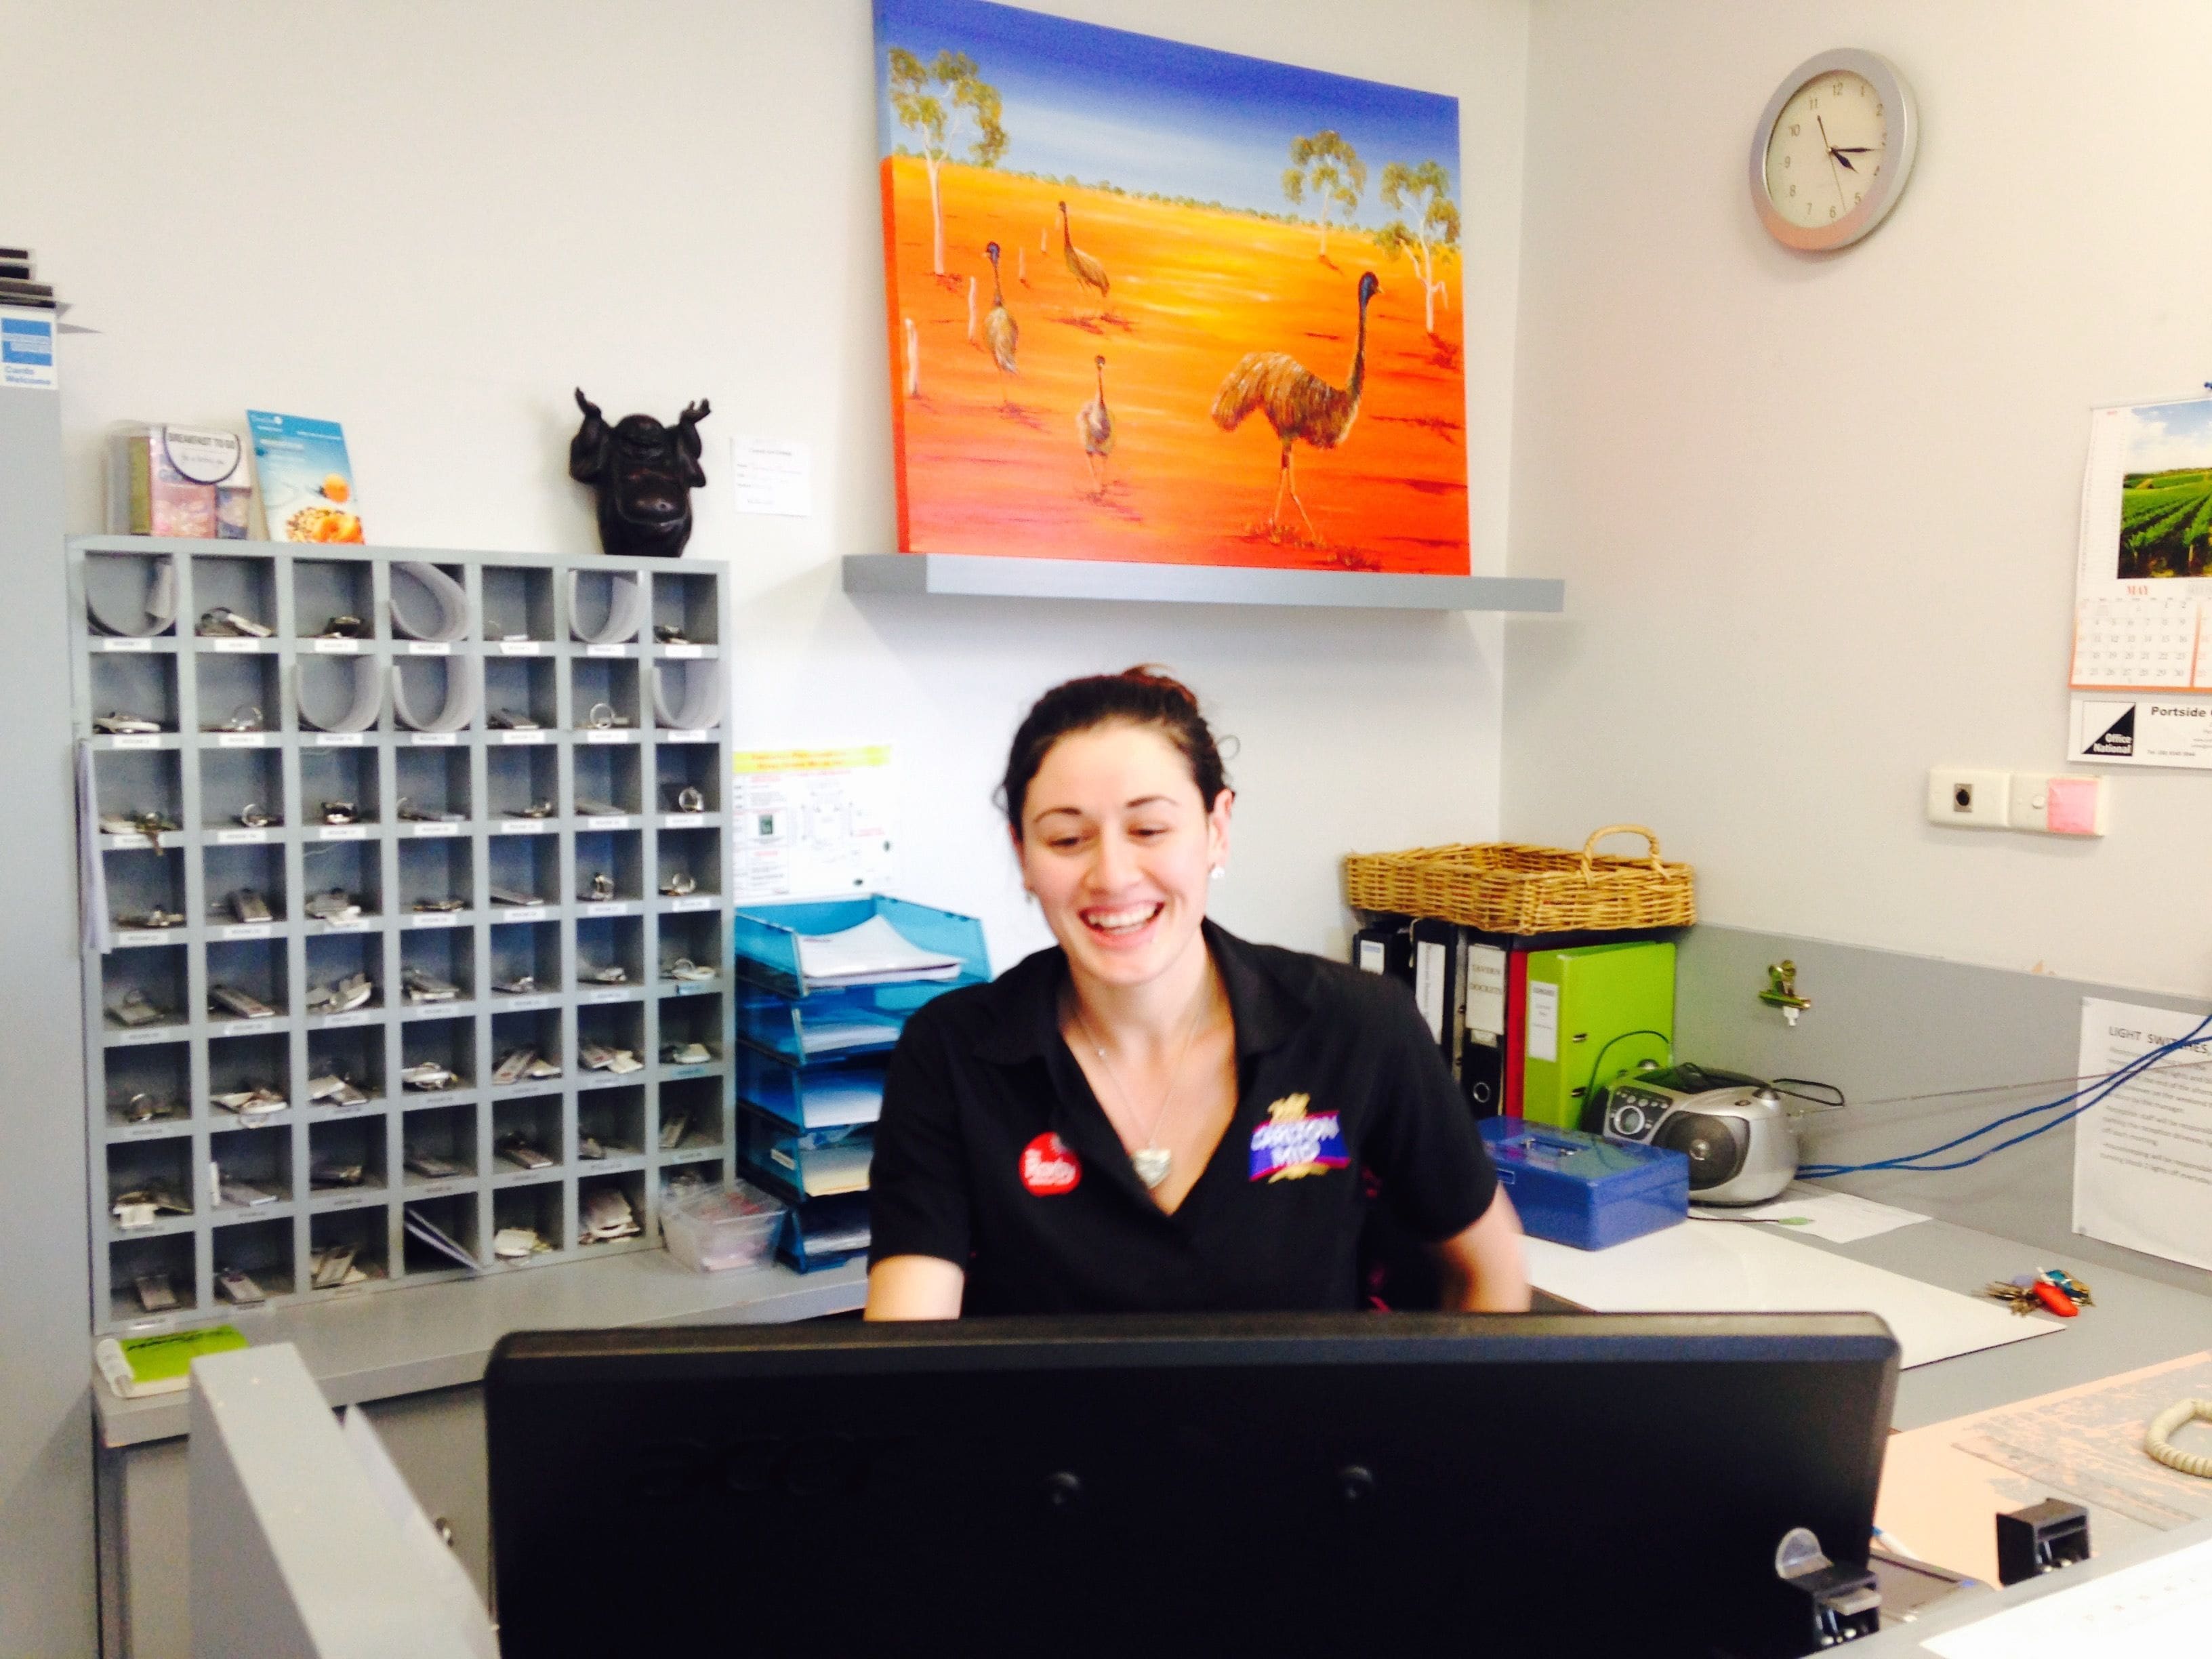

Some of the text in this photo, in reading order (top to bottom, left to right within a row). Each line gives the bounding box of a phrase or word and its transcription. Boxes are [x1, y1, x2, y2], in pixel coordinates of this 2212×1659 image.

[2151, 706, 2207, 717] Portside
[2104, 732, 2132, 744] Office
[2093, 743, 2133, 754] National
[2109, 1025, 2209, 1054] LIGHT SWITES
